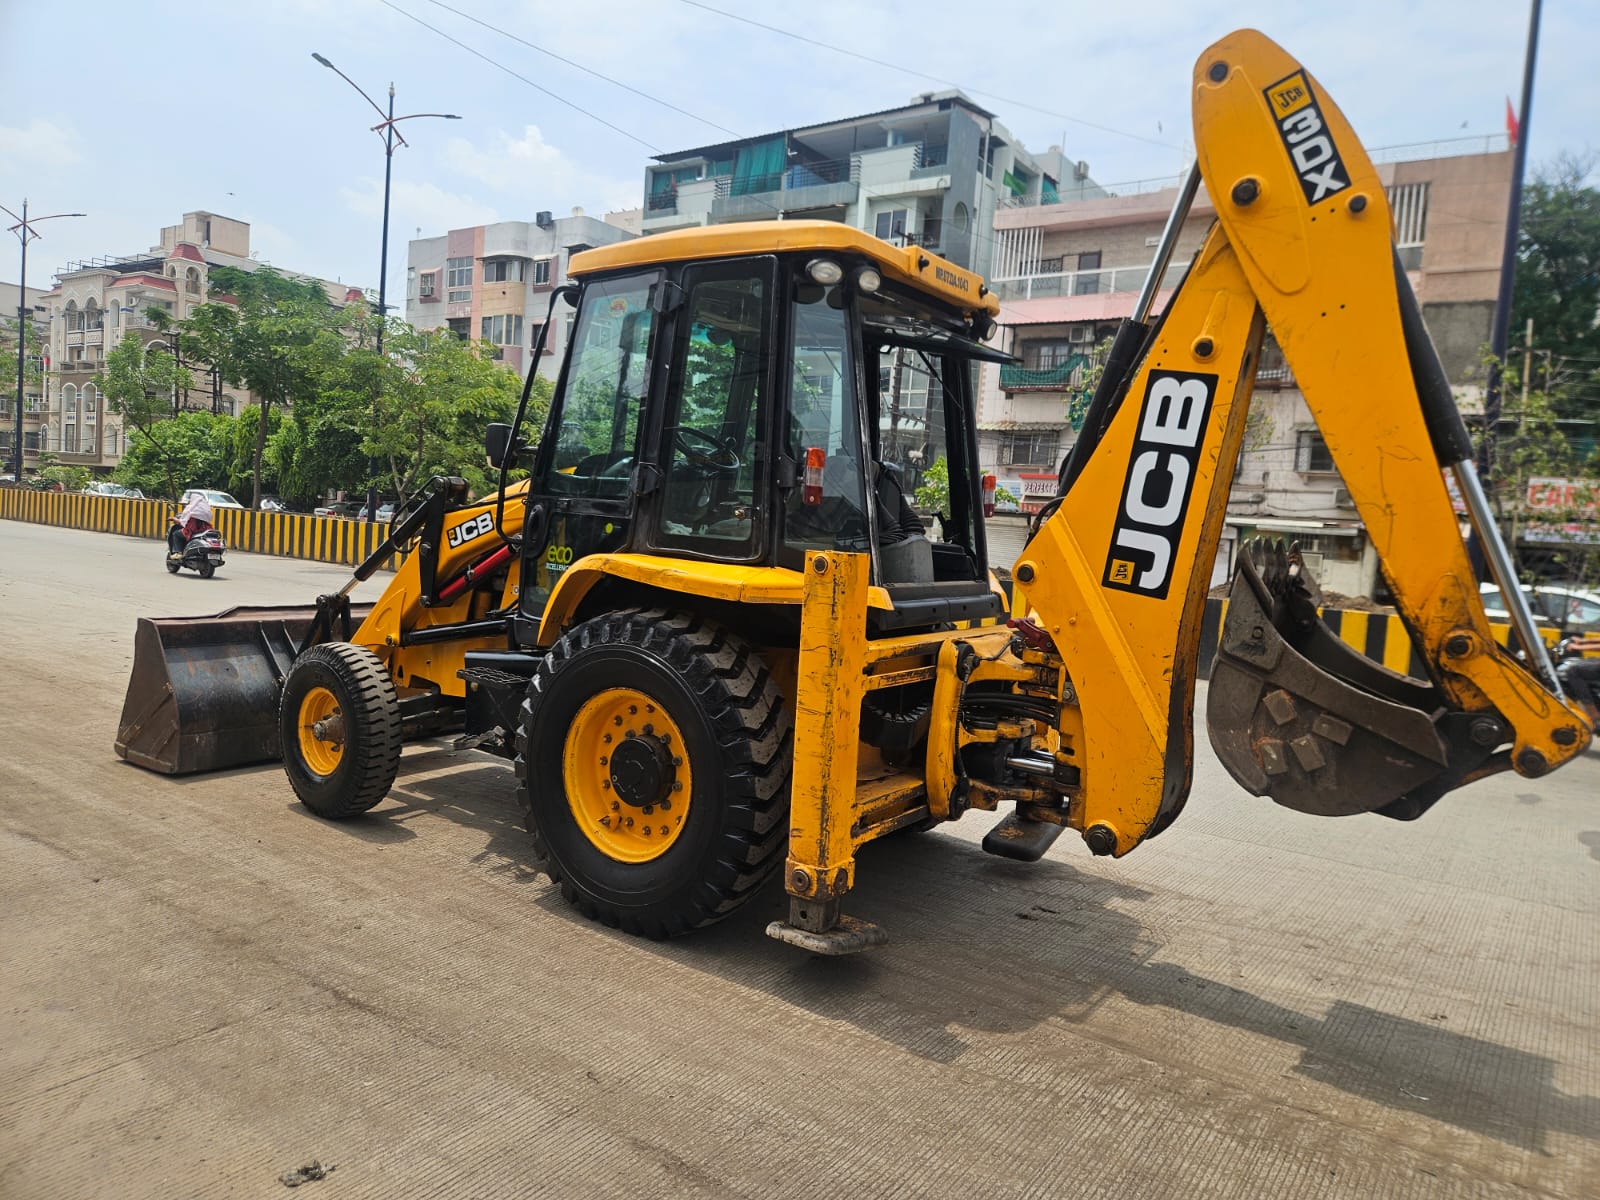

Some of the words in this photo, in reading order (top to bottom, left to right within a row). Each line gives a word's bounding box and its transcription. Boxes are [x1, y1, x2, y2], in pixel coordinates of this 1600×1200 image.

[1277, 85, 1304, 109] JCB
[1282, 107, 1346, 202] 3DX
[1024, 482, 1053, 494] PERFECT
[1116, 376, 1209, 590] JCB
[450, 512, 494, 547] JCB
[547, 545, 573, 564] eco
[545, 562, 570, 571] EXCELLENC
[1114, 563, 1129, 580] JCB
